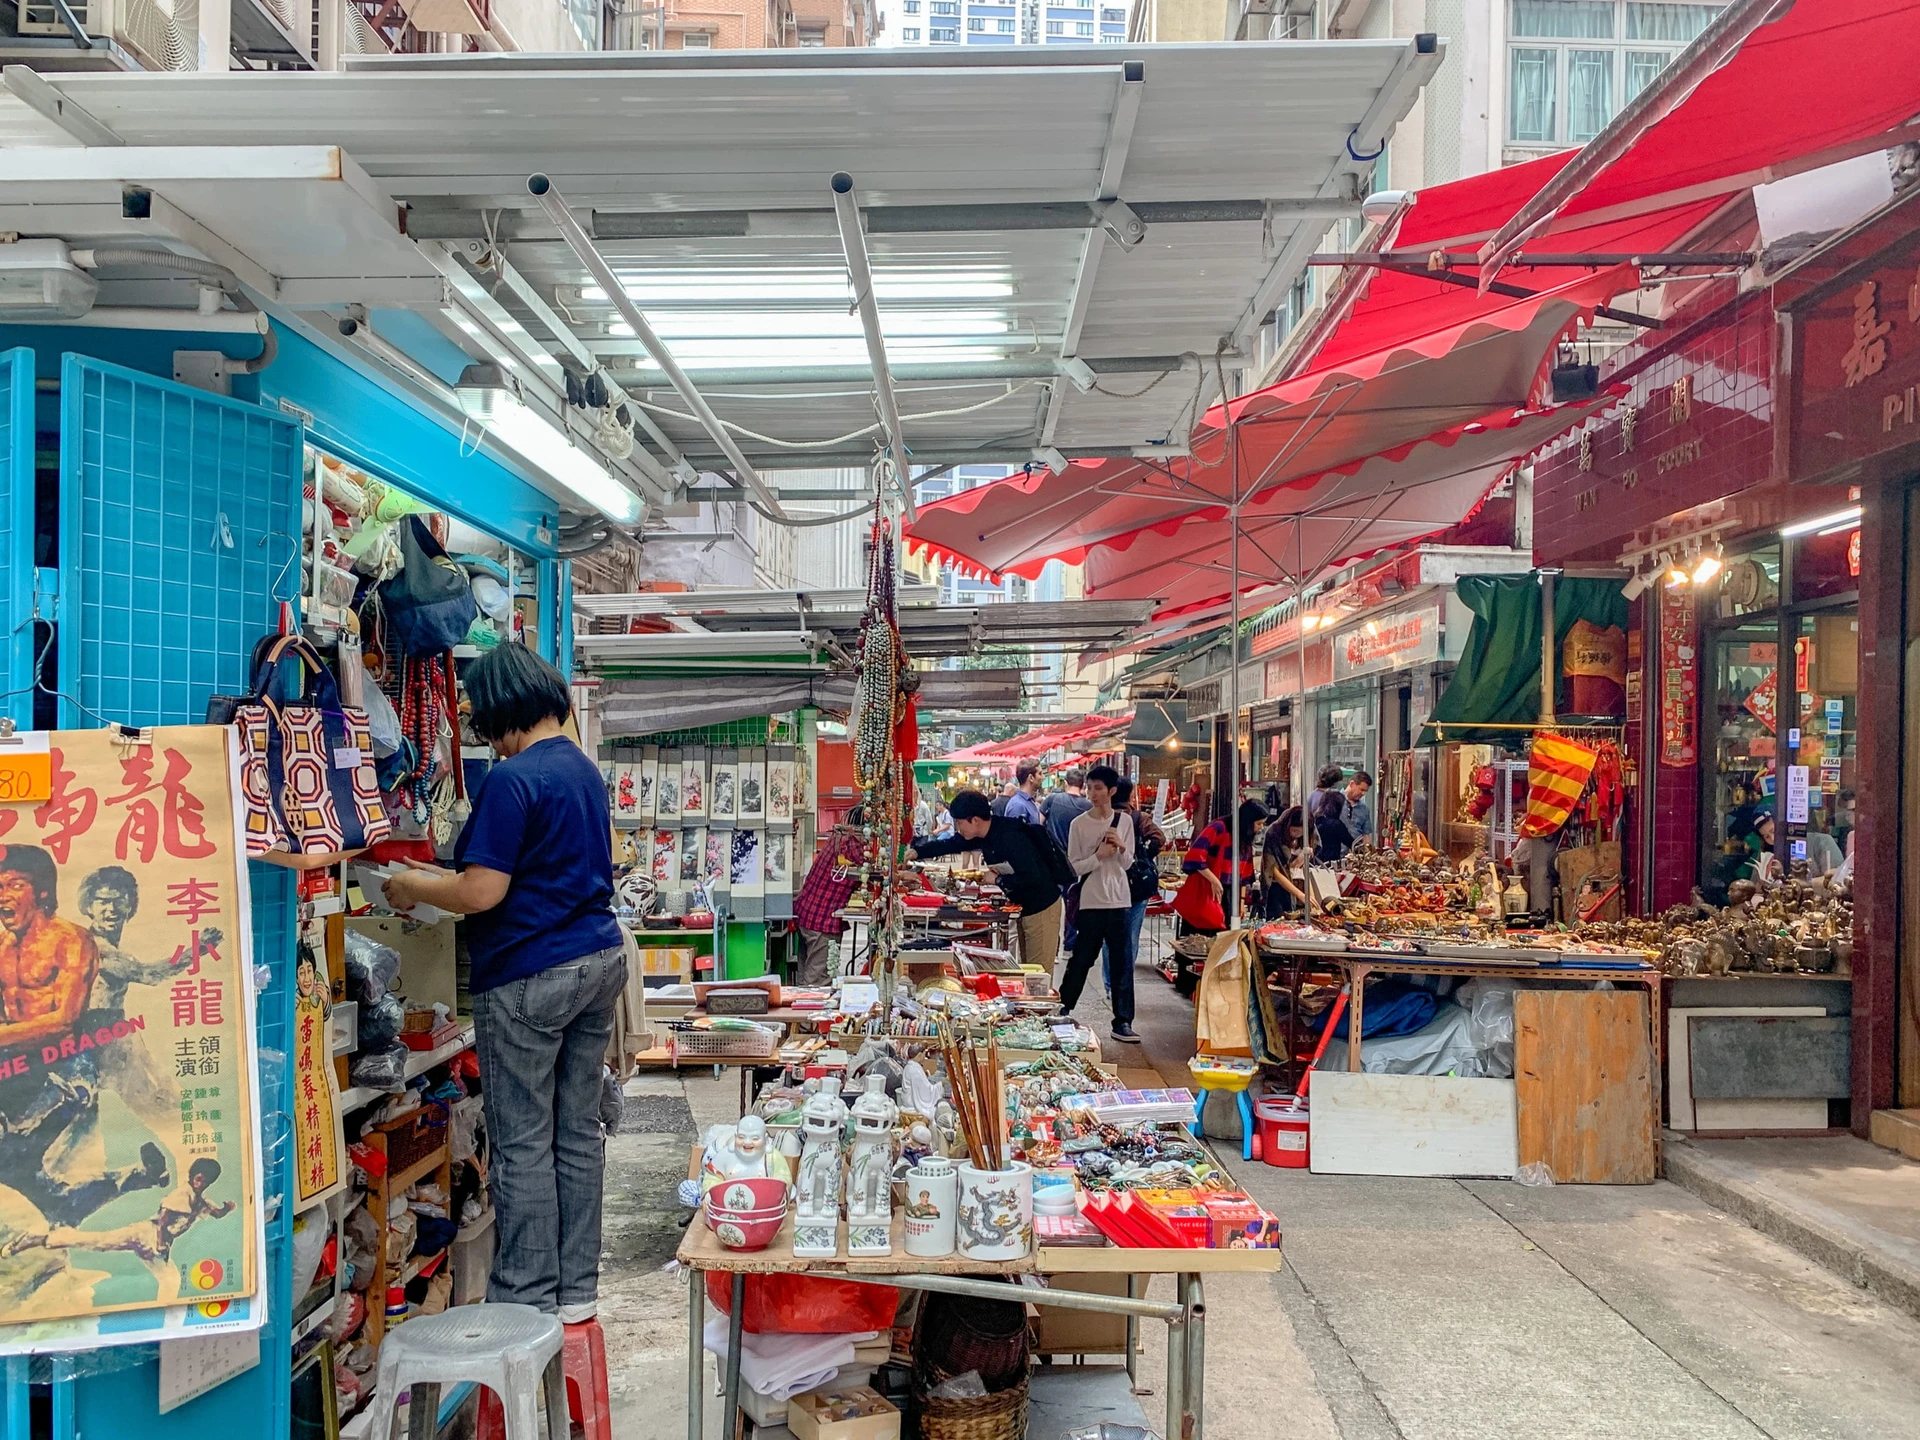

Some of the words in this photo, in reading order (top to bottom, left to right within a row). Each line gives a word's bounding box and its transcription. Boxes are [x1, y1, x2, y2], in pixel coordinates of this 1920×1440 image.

[1883, 384, 1920, 433] PI
[1657, 438, 1704, 475] COURT
[1822, 758, 1840, 766] VISA
[166, 877, 225, 1028] 李小龍
[41, 1014, 146, 1065] DRAGON
